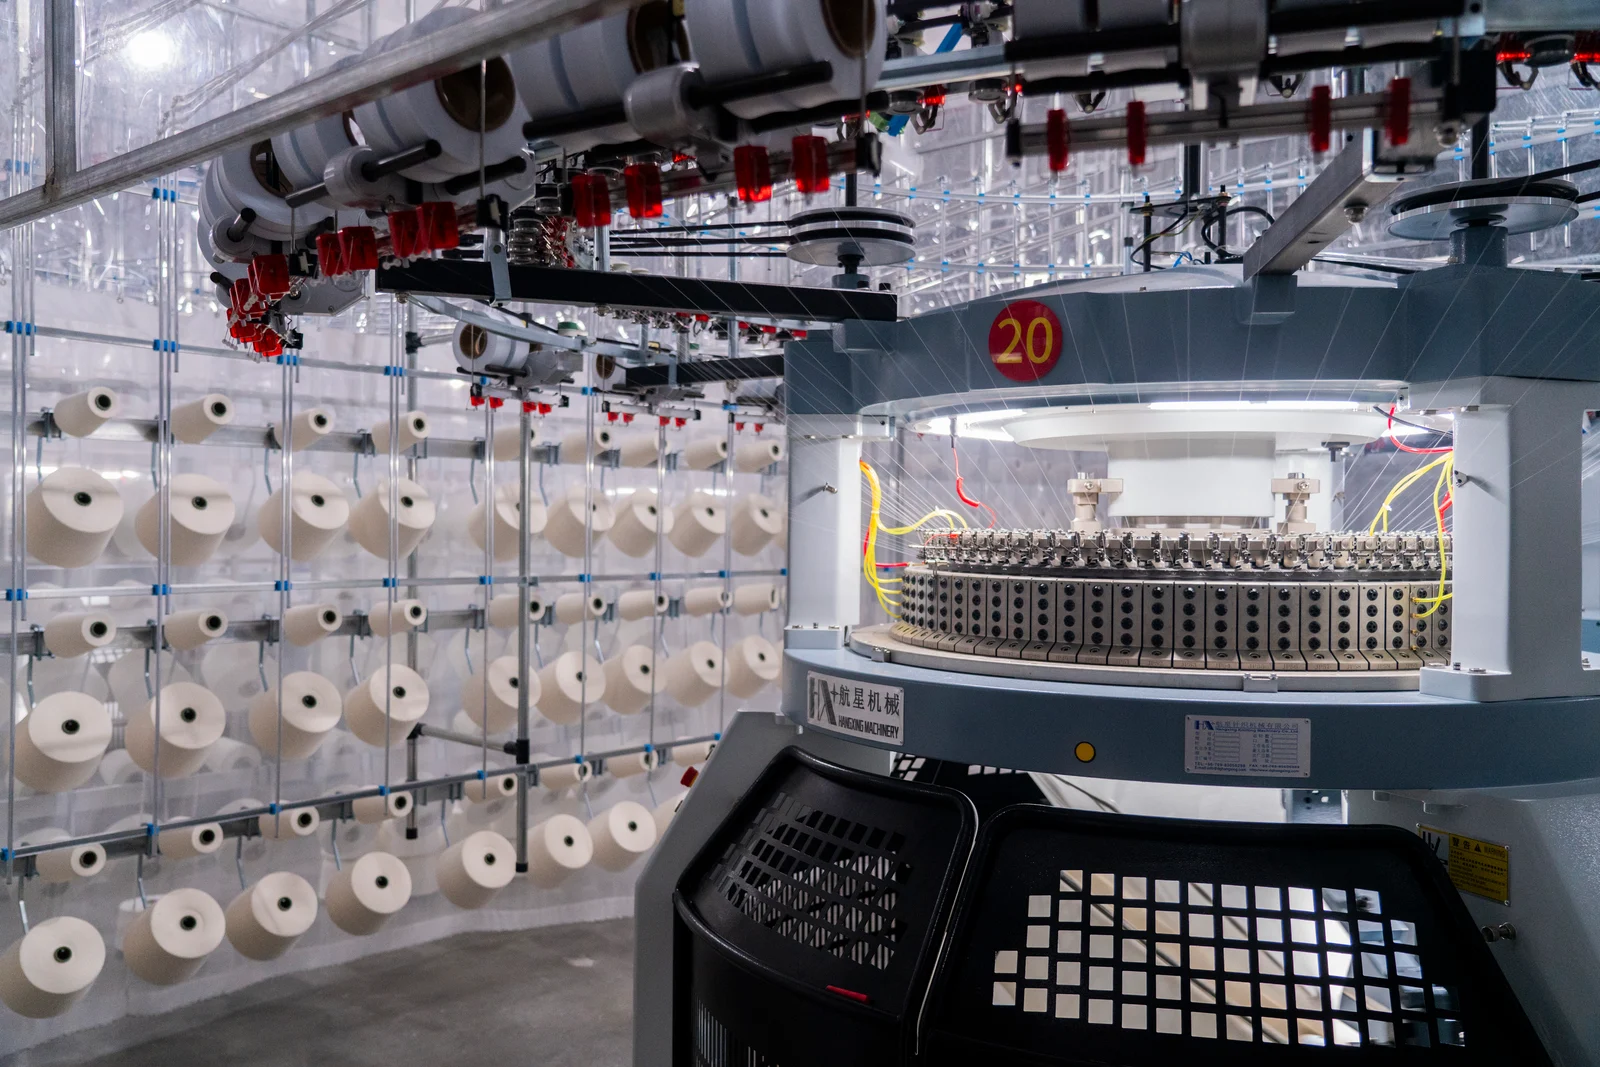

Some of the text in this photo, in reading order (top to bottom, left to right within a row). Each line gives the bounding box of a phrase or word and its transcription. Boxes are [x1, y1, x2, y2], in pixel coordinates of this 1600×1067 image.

[998, 317, 1053, 364] 20
[839, 684, 900, 716] 航星机械
[838, 715, 899, 739] HANGXING MACHINERY
